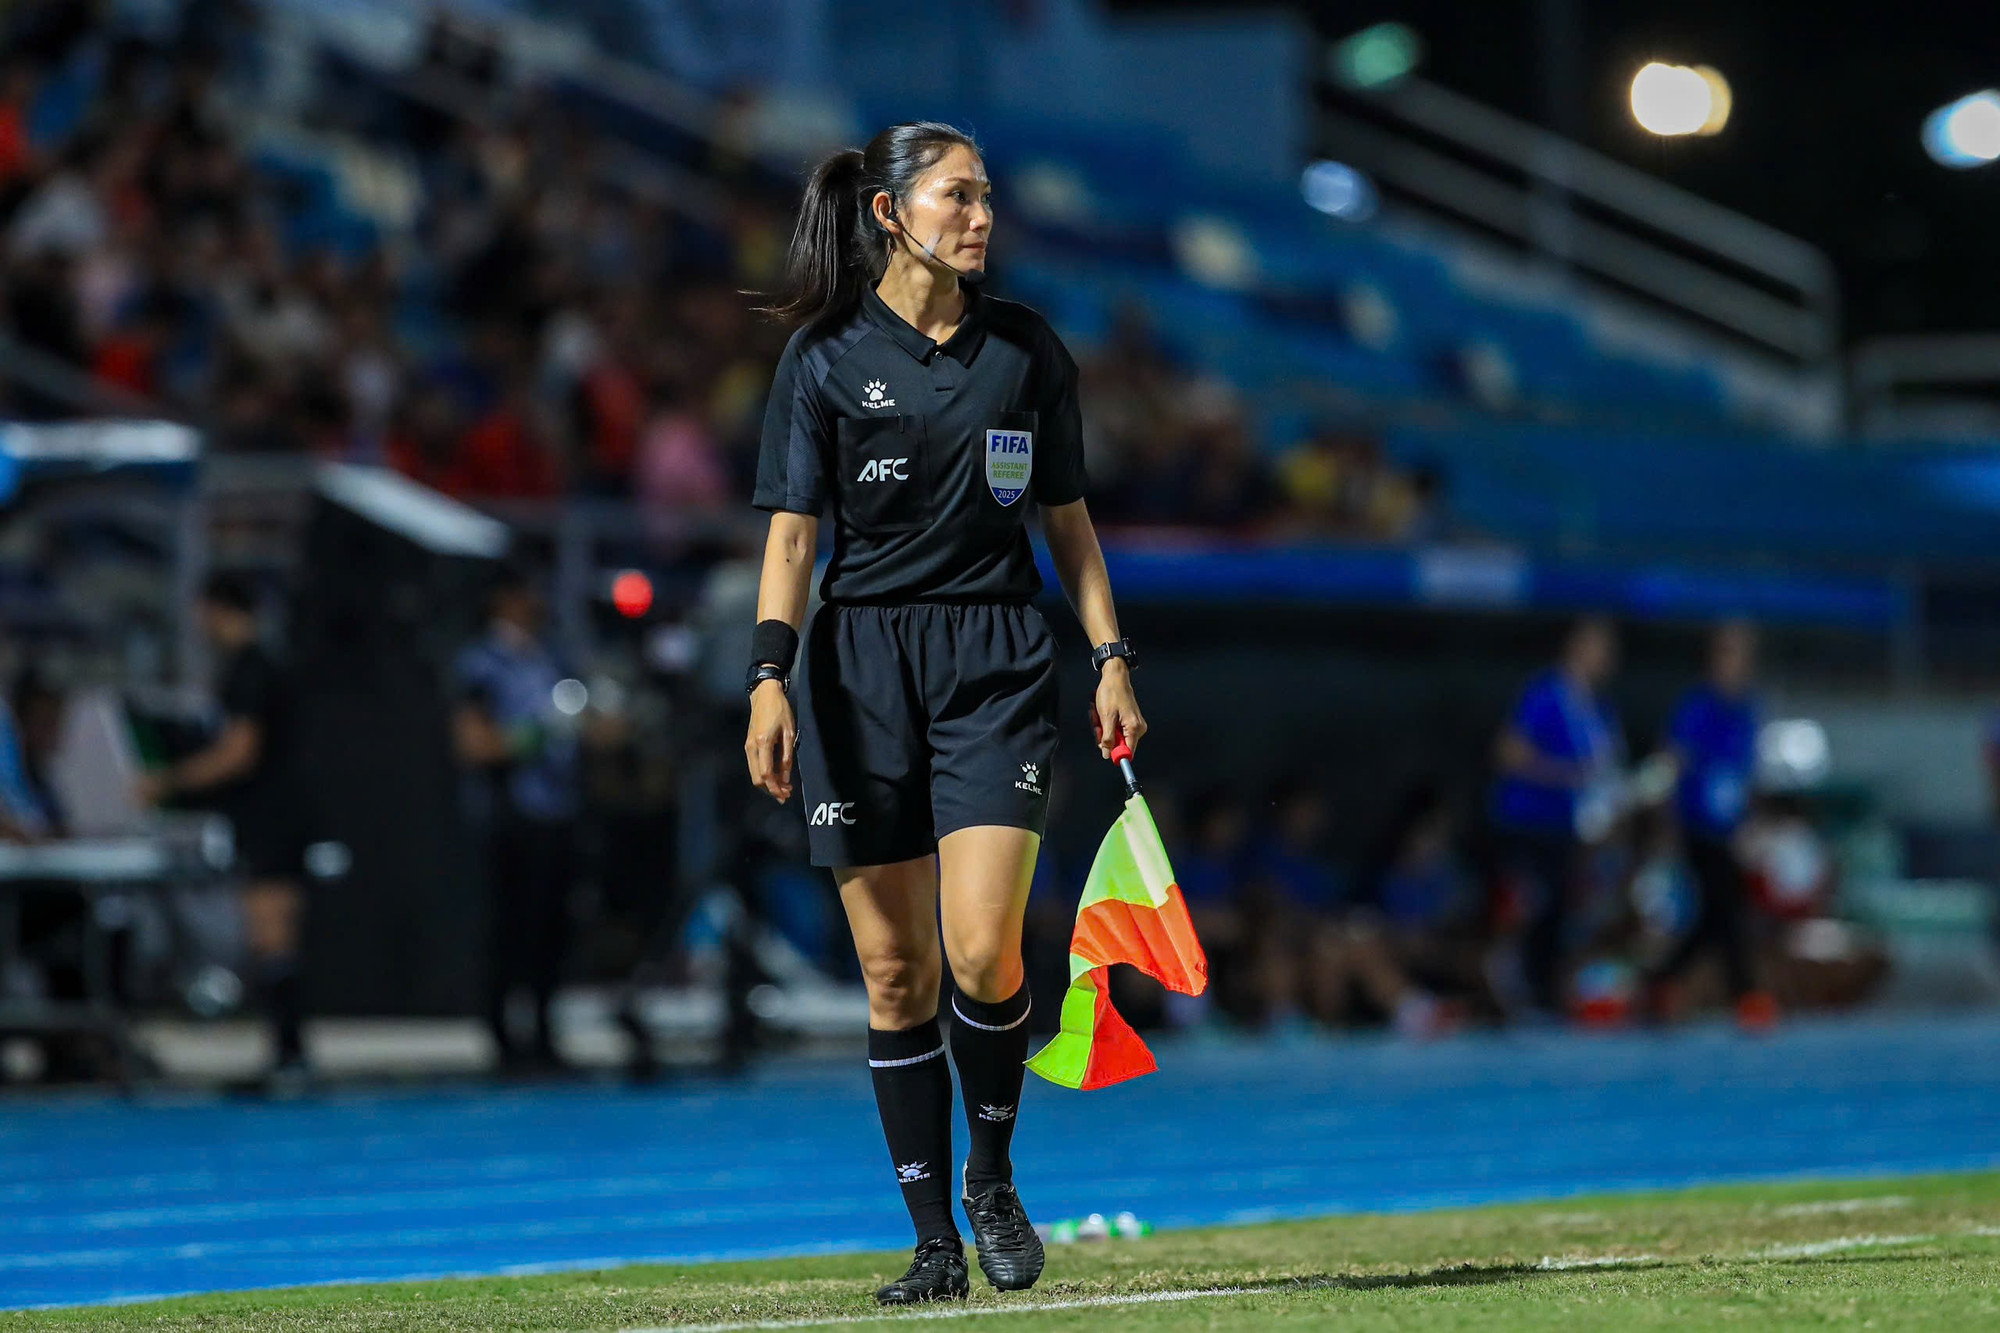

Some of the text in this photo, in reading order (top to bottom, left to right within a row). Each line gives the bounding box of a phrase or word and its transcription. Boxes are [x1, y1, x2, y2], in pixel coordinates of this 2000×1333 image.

[861, 399, 896, 409] KELME
[991, 434, 1029, 454] FIFA
[857, 458, 909, 482] AFC
[991, 462, 1028, 471] ASSISTANT
[993, 470, 1025, 480] REFEREE
[998, 490, 1015, 499] 2025
[1015, 780, 1043, 795] KELME
[810, 802, 857, 826] AFC
[898, 1172, 931, 1183] KELME
